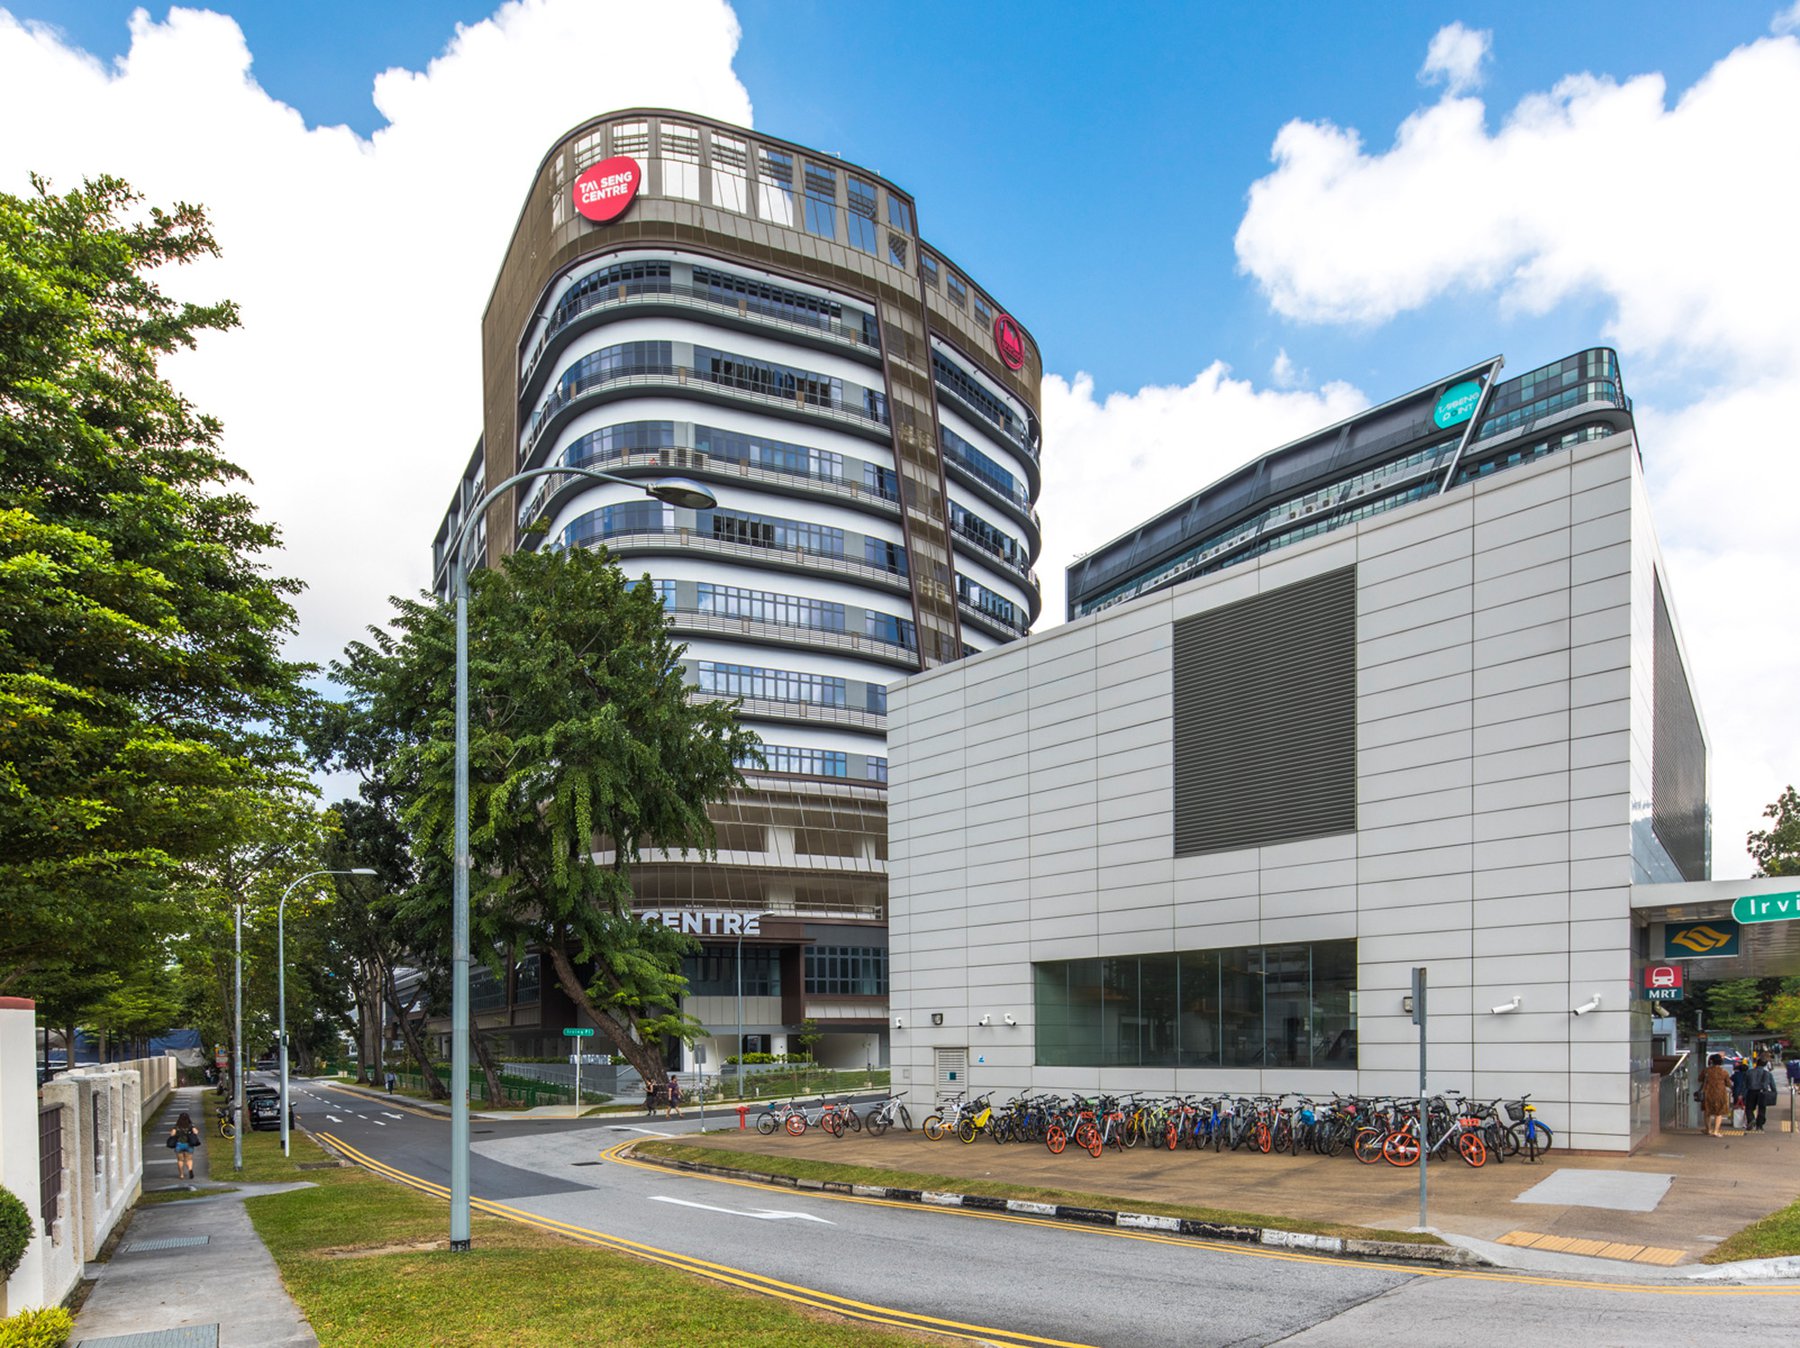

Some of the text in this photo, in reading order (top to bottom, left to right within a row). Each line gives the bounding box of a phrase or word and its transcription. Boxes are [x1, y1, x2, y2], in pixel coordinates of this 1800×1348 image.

[579, 171, 633, 194] TAI SENG
[582, 183, 629, 204] CENTRE
[1750, 893, 1800, 916] Irvi
[1649, 988, 1678, 999] MRT
